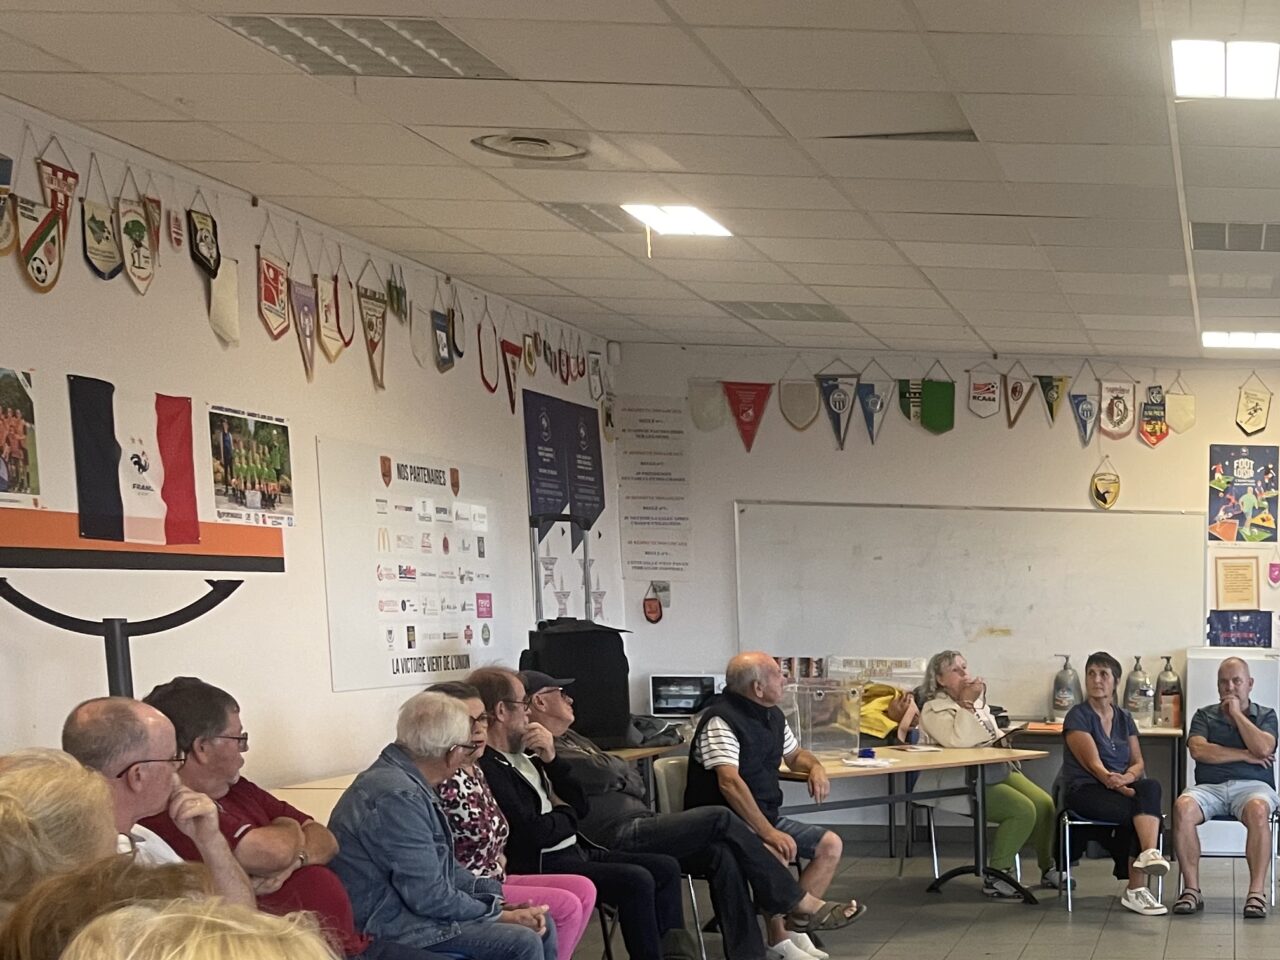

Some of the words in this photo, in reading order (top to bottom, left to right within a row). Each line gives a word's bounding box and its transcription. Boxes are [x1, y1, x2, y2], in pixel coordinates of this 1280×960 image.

[396, 462, 409, 481] NOS
[409, 465, 446, 487] PARTENAIRES
[391, 658, 400, 675] LA
[400, 656, 426, 674] VICTOIRE
[426, 655, 442, 673] VIENT
[443, 655, 450, 671] DE
